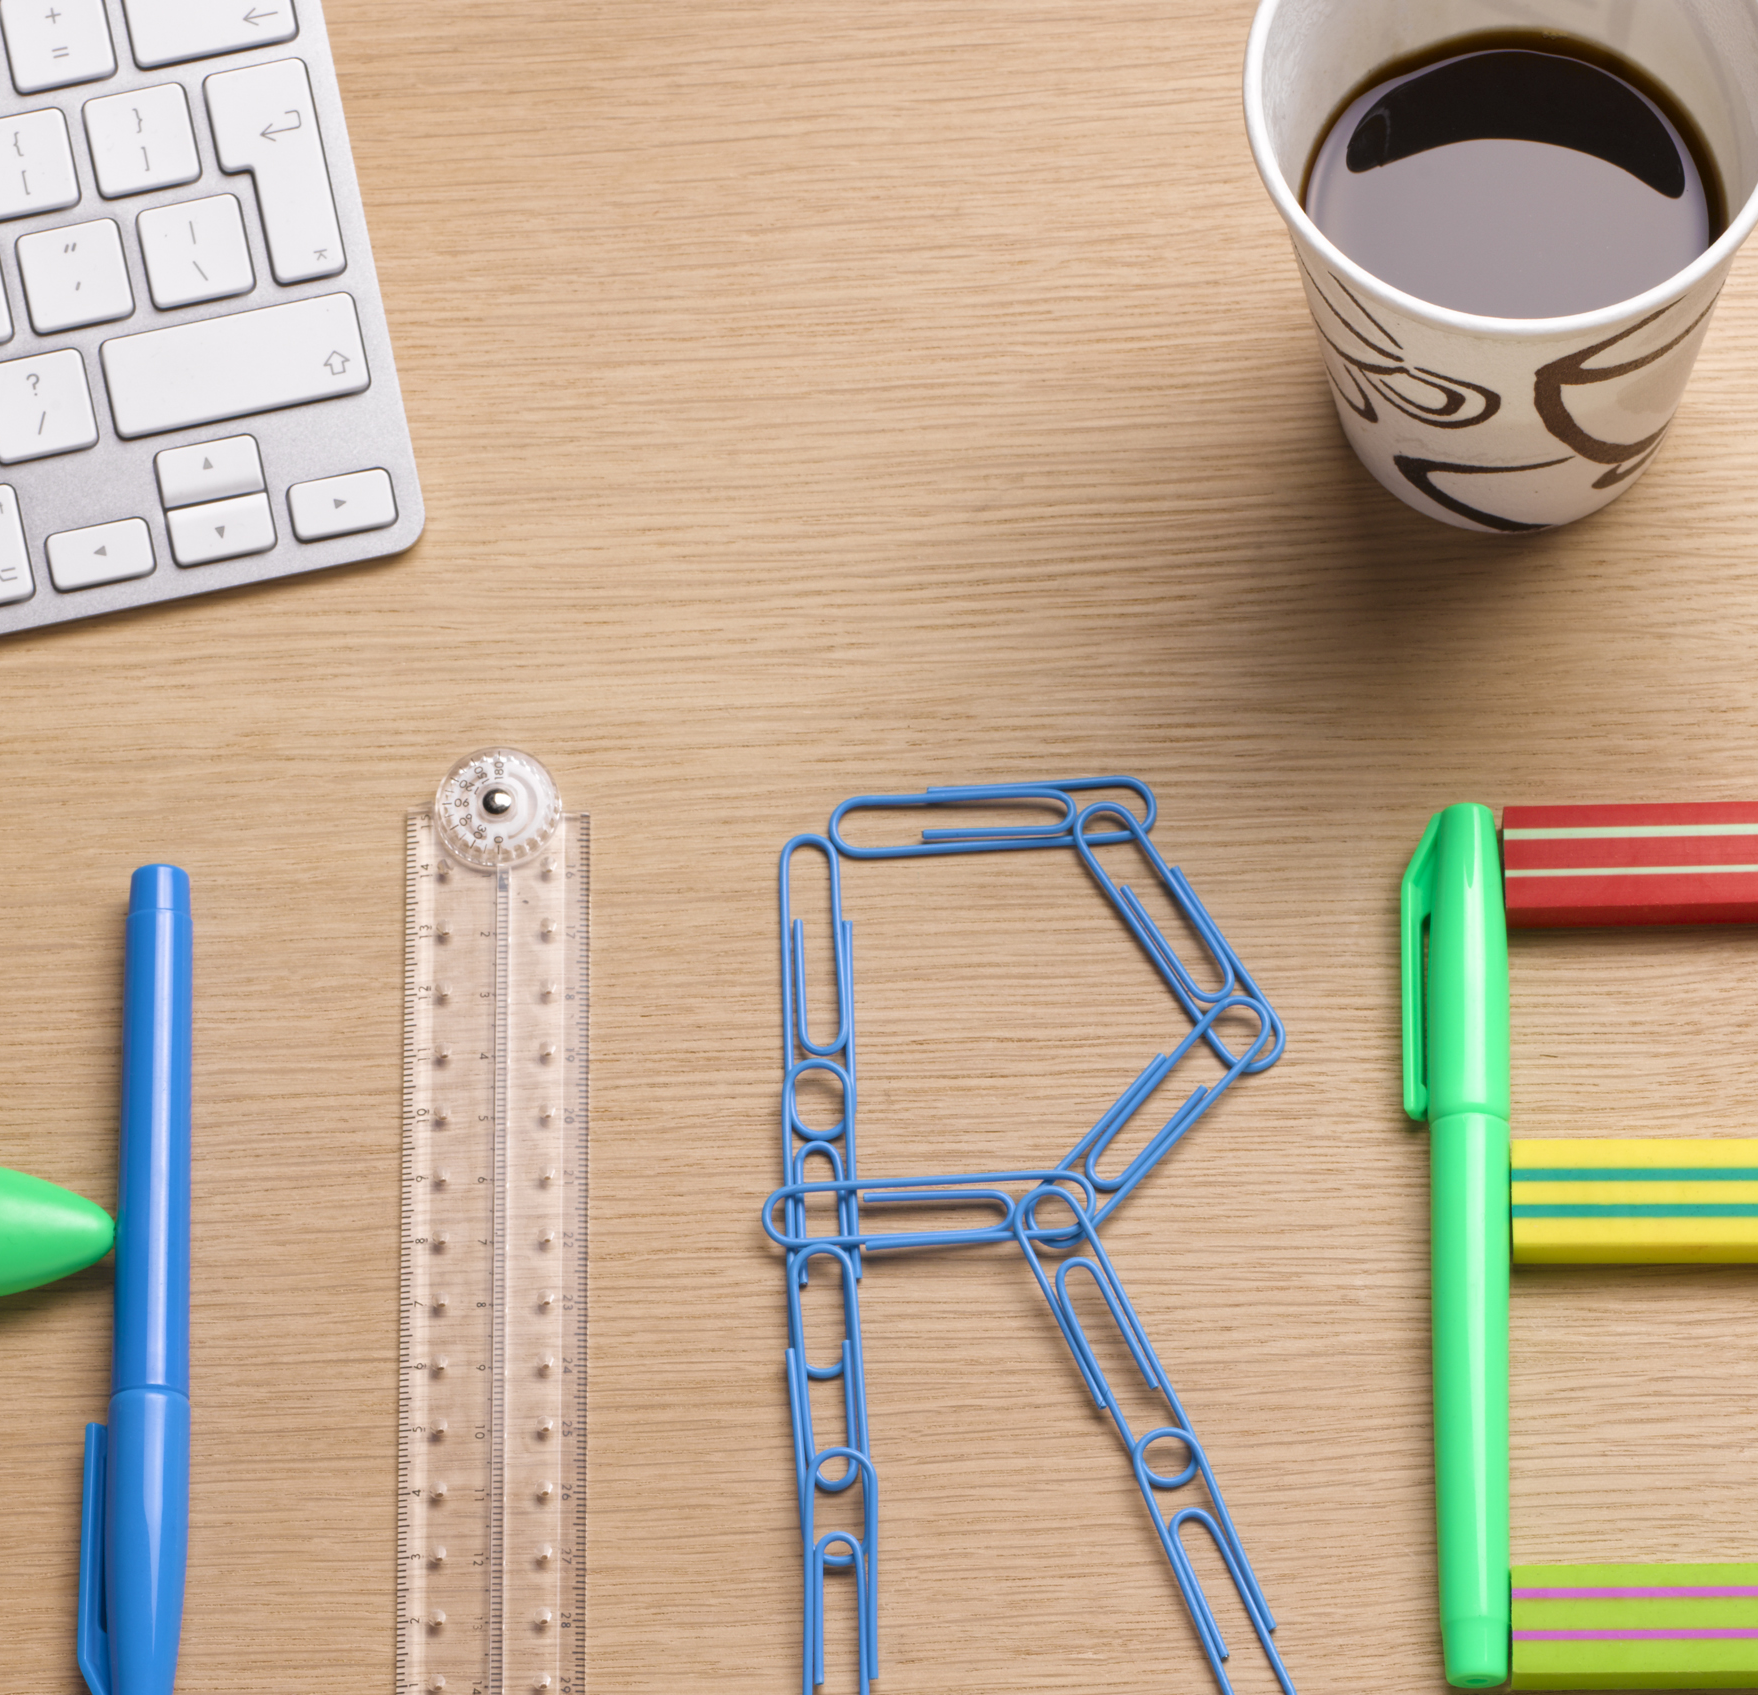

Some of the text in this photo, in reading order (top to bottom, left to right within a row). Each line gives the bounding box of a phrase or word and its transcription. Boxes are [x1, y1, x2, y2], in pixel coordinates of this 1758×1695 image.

[473, 765, 490, 785] 150
[493, 760, 504, 780] 180
[459, 779, 480, 796] 120
[454, 797, 470, 808] 90
[420, 813, 432, 829] 15
[458, 813, 474, 827] 60
[472, 823, 487, 840] 30
[493, 835, 504, 844] 0
[419, 863, 431, 878] 14
[565, 863, 576, 879] 16
[418, 924, 430, 940] 13
[565, 924, 576, 940] 17
[418, 985, 430, 1001] 12
[564, 985, 576, 1001] 18
[417, 1047, 429, 1062] 11
[565, 1047, 576, 1063] 19
[416, 1108, 428, 1124] 10
[563, 1107, 575, 1125] 20
[563, 1169, 575, 1186] 21
[414, 1237, 426, 1245] 8
[562, 1231, 574, 1249] 22
[413, 1300, 424, 1308] 7
[562, 1294, 574, 1311] 23
[562, 1357, 573, 1375] 24
[412, 1425, 424, 1433] 5
[561, 1420, 573, 1437] 25
[411, 1488, 422, 1497] 4
[561, 1484, 573, 1501] 26
[410, 1552, 422, 1561] 3
[561, 1547, 572, 1565] 27
[409, 1617, 420, 1625] 2
[560, 1612, 572, 1629] 28
[560, 1676, 572, 1694] 29
